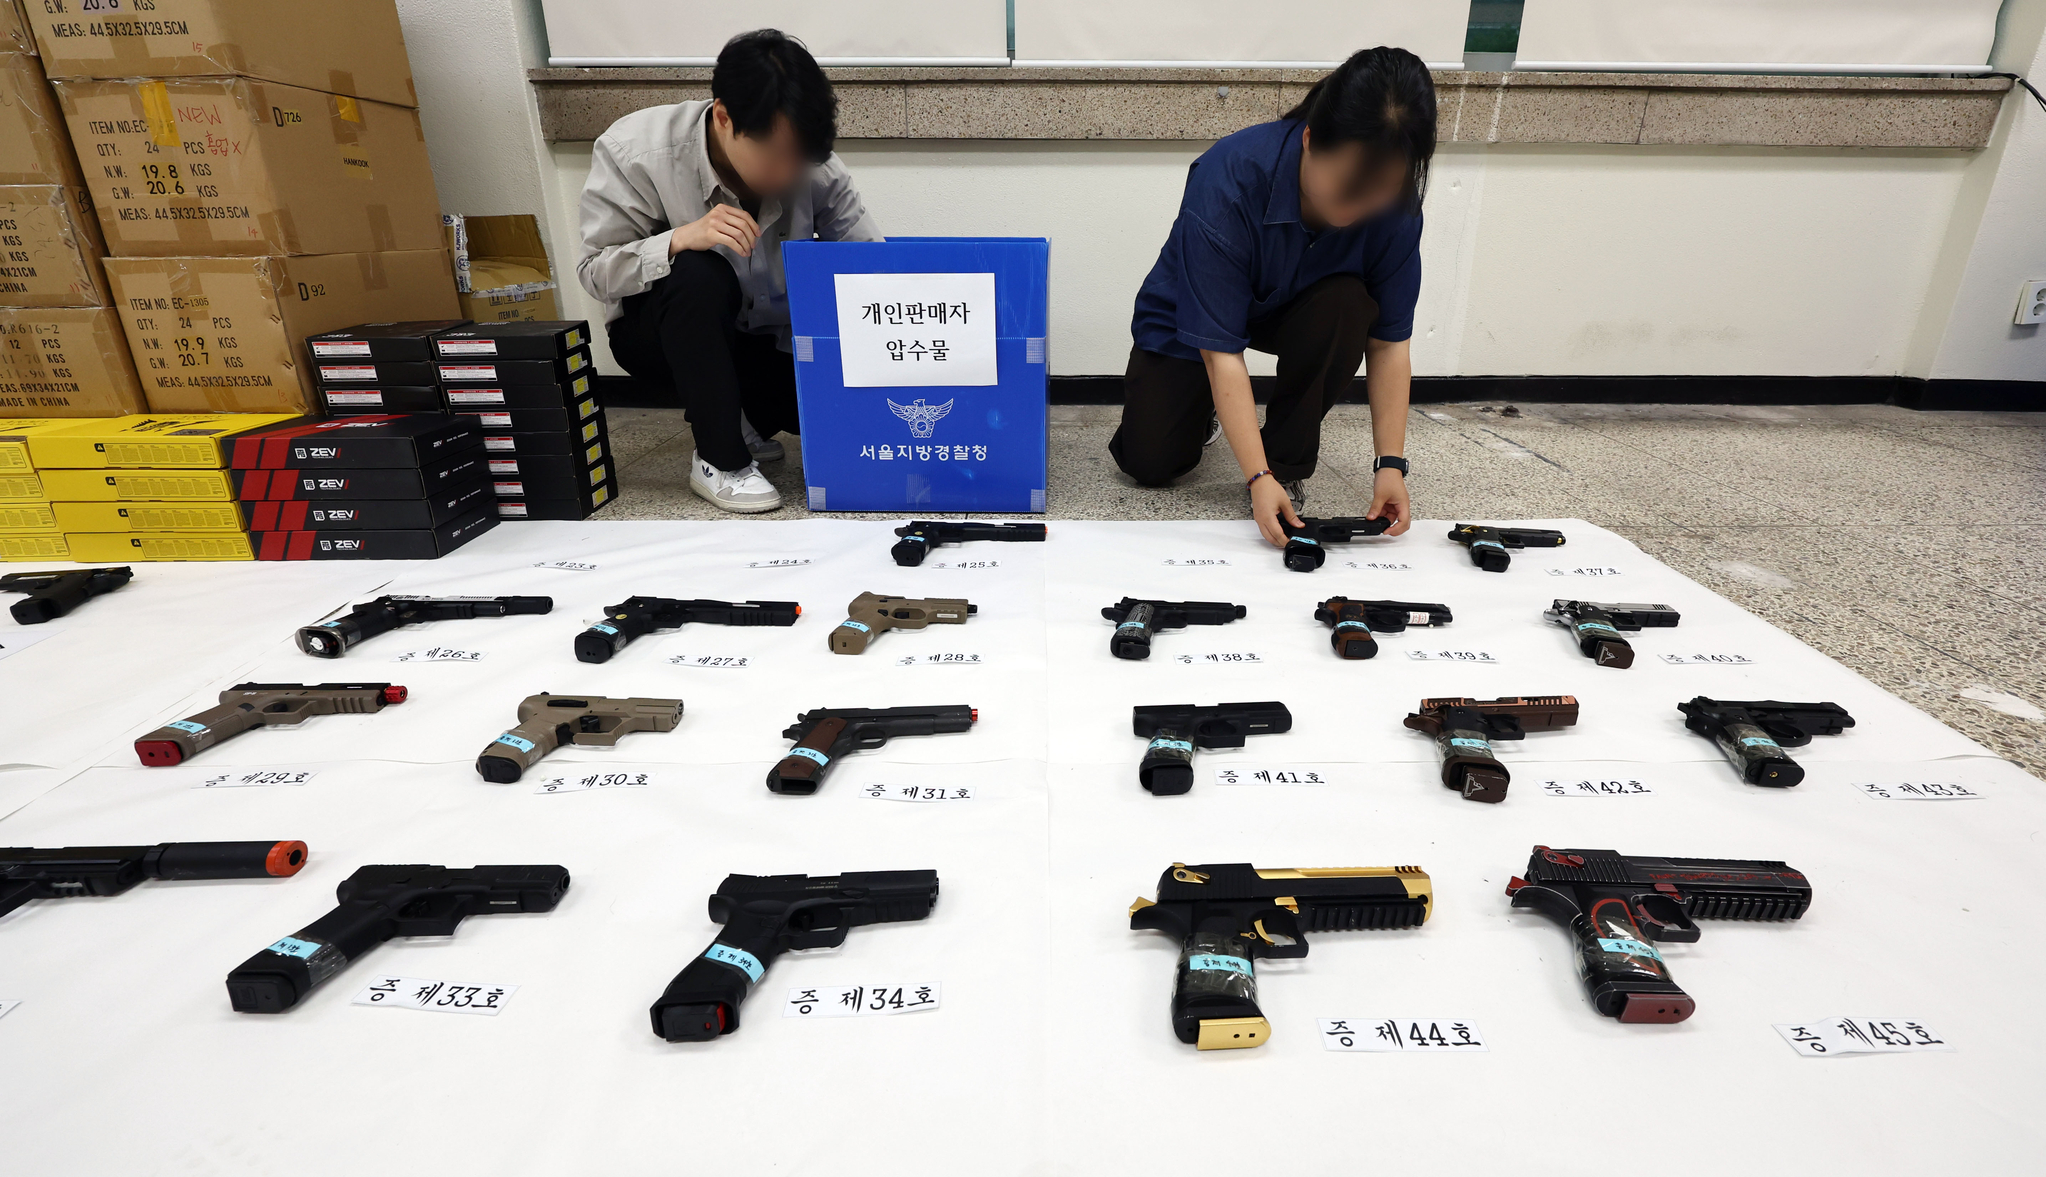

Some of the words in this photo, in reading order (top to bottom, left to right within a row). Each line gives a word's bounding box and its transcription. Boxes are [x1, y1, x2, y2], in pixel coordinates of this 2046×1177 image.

[133, 0, 155, 11] KGS
[52, 23, 86, 38] MEAS:
[90, 20, 189, 37] 44.5X32.5X29.5CM
[178, 104, 222, 126] NEW
[272, 106, 284, 128] D
[284, 112, 302, 122] 726
[88, 121, 116, 134] ITEM
[96, 143, 122, 156] QTY:
[144, 141, 160, 154] 24
[183, 141, 205, 154] PCS
[342, 157, 370, 168] HANKOOK
[104, 165, 128, 178] N.W:
[142, 165, 178, 178] 19.8
[189, 163, 212, 176] KGS
[112, 187, 134, 200] G.W:
[146, 180, 185, 195] 20.6
[196, 185, 219, 198] KGS
[118, 208, 151, 221] MEAS:
[154, 206, 250, 220] 44.5X32.5X29.5CM
[2, 235, 23, 246] KGS
[8, 251, 30, 262] KGS
[298, 282, 310, 301] D
[311, 284, 326, 298] 92
[130, 298, 153, 311] ITEM
[155, 298, 170, 310] NO:
[172, 297, 210, 310] EC-1305
[498, 310, 512, 321] ITEM
[861, 302, 971, 326] 개인판매자
[136, 318, 159, 331] QTY:
[178, 317, 192, 329] 24
[212, 317, 232, 329] PCS
[9, 340, 21, 350] 12
[42, 338, 62, 348] PCS
[142, 338, 164, 350] N.W:
[174, 337, 206, 352] 19.9
[218, 337, 238, 349] KGS
[886, 338, 950, 362] 압수물
[46, 354, 66, 364] KGS
[149, 357, 170, 370] G.W:
[178, 352, 210, 368] 20.7
[223, 356, 244, 368] KGS
[52, 368, 72, 378] KGS
[156, 376, 186, 388] MEAS:
[188, 376, 273, 388] 44.5X32.5X29.5CM
[26, 397, 38, 407] IN
[40, 397, 71, 407] CHINA
[310, 448, 336, 457] ZEV
[860, 444, 988, 462] 서울지방경찰청
[318, 479, 344, 488] ZEV
[328, 510, 354, 519] ZEV
[334, 540, 360, 548] ZEV
[958, 560, 1000, 569] 제25호
[1573, 566, 1622, 576] 제37호
[427, 647, 481, 661] 제26호
[697, 655, 748, 666] 제27호
[928, 653, 982, 663] 제28호
[1205, 653, 1260, 664] 제38호
[1438, 650, 1497, 662] 제39호
[1693, 653, 1753, 664] 제40호
[240, 771, 310, 784] 제29호
[543, 778, 564, 792] 증
[580, 774, 648, 788] 제30호
[1218, 770, 1240, 784] 증
[1254, 769, 1326, 784] 제41호
[866, 784, 886, 798] 증
[902, 786, 970, 800] 제31호
[1544, 780, 1566, 795] 증
[1576, 780, 1652, 796] 제42호
[1864, 784, 1891, 799] 증
[1897, 782, 1977, 798] 제43호
[370, 978, 400, 1002] 증
[411, 982, 504, 1008] 제33호
[790, 989, 820, 1015] 증
[838, 986, 936, 1014] 제34호
[1326, 1020, 1356, 1048] 증
[1376, 1019, 1482, 1050] 제44호
[1790, 1026, 1827, 1054] 증
[1836, 1017, 1944, 1047] 제45호
